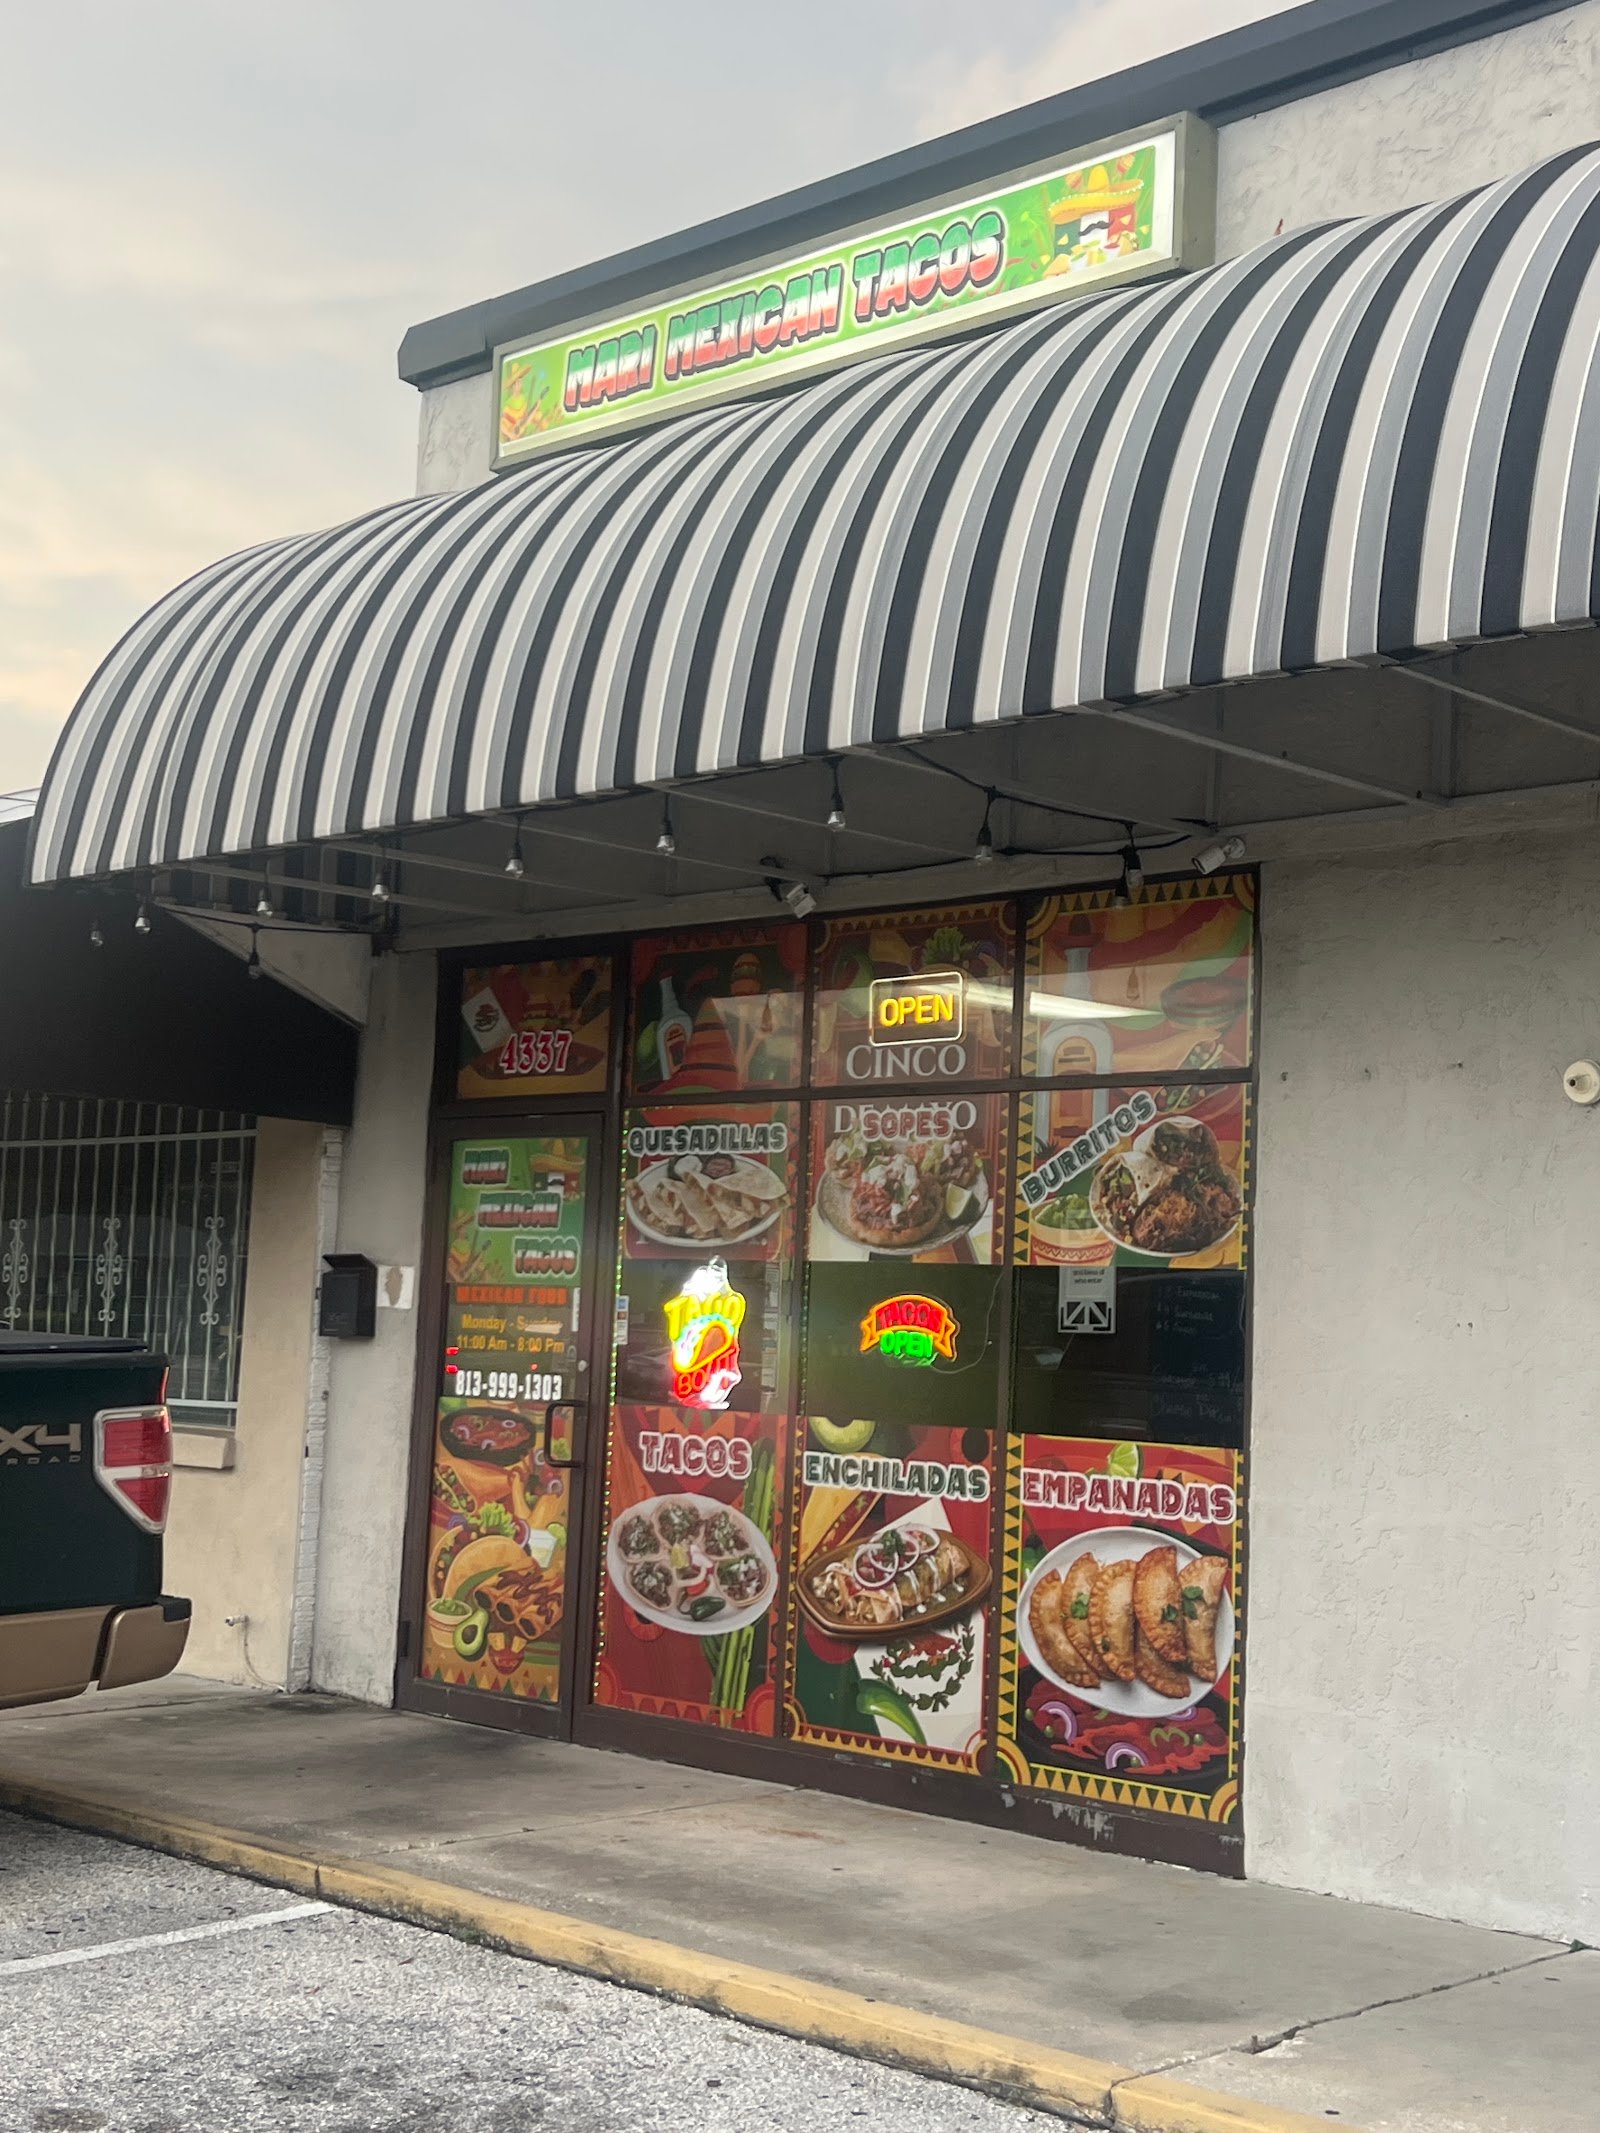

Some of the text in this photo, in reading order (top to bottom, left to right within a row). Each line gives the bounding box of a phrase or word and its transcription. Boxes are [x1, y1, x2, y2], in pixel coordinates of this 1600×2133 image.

[564, 211, 1005, 412] MARI MEXICAN TACOS
[878, 992, 954, 1028] OPEN
[500, 1029, 573, 1074] 4337
[845, 1044, 967, 1080] CINCO
[628, 1122, 788, 1157] QUESADILLAS
[862, 1108, 954, 1143] SOPES
[1019, 1089, 1159, 1208] BURRITOS
[461, 1314, 507, 1333] Monday
[877, 1301, 942, 1333] TACOS
[457, 1335, 486, 1350] 11:00
[487, 1336, 508, 1351] Am
[517, 1336, 542, 1353] 8:00
[544, 1337, 565, 1353] Pm
[880, 1330, 934, 1359] OPEN
[455, 1369, 562, 1401] 813-999-1303
[7, 1455, 80, 1465] ROAD
[640, 1431, 752, 1480] TACOS
[802, 1450, 990, 1502] ENCHILADAS
[1020, 1466, 1237, 1525] EMPANADAS
